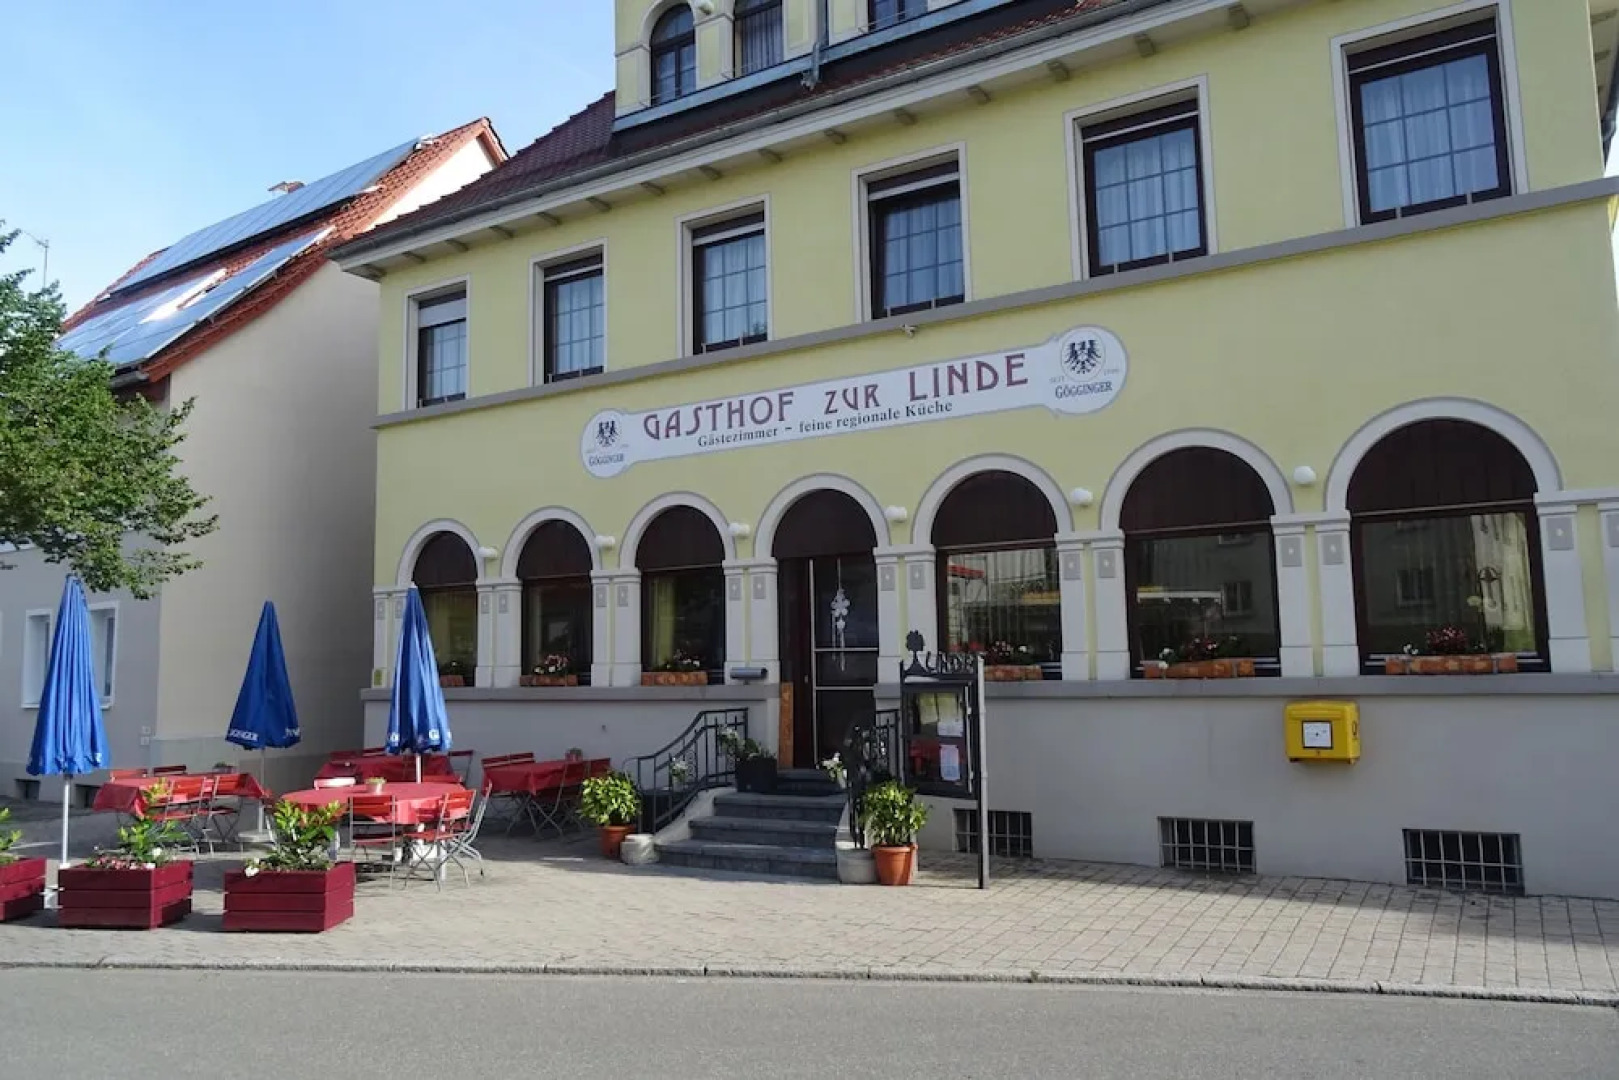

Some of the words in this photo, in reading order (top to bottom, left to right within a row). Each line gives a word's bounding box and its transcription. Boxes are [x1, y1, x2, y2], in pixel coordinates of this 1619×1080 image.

[643, 391, 794, 440] GASTHOF
[824, 383, 880, 415] ZUR
[909, 353, 1028, 402] LINDE
[697, 427, 778, 447] Gästezimmer
[799, 420, 832, 433] feine
[836, 408, 900, 428] regionale
[906, 400, 953, 417] Küche
